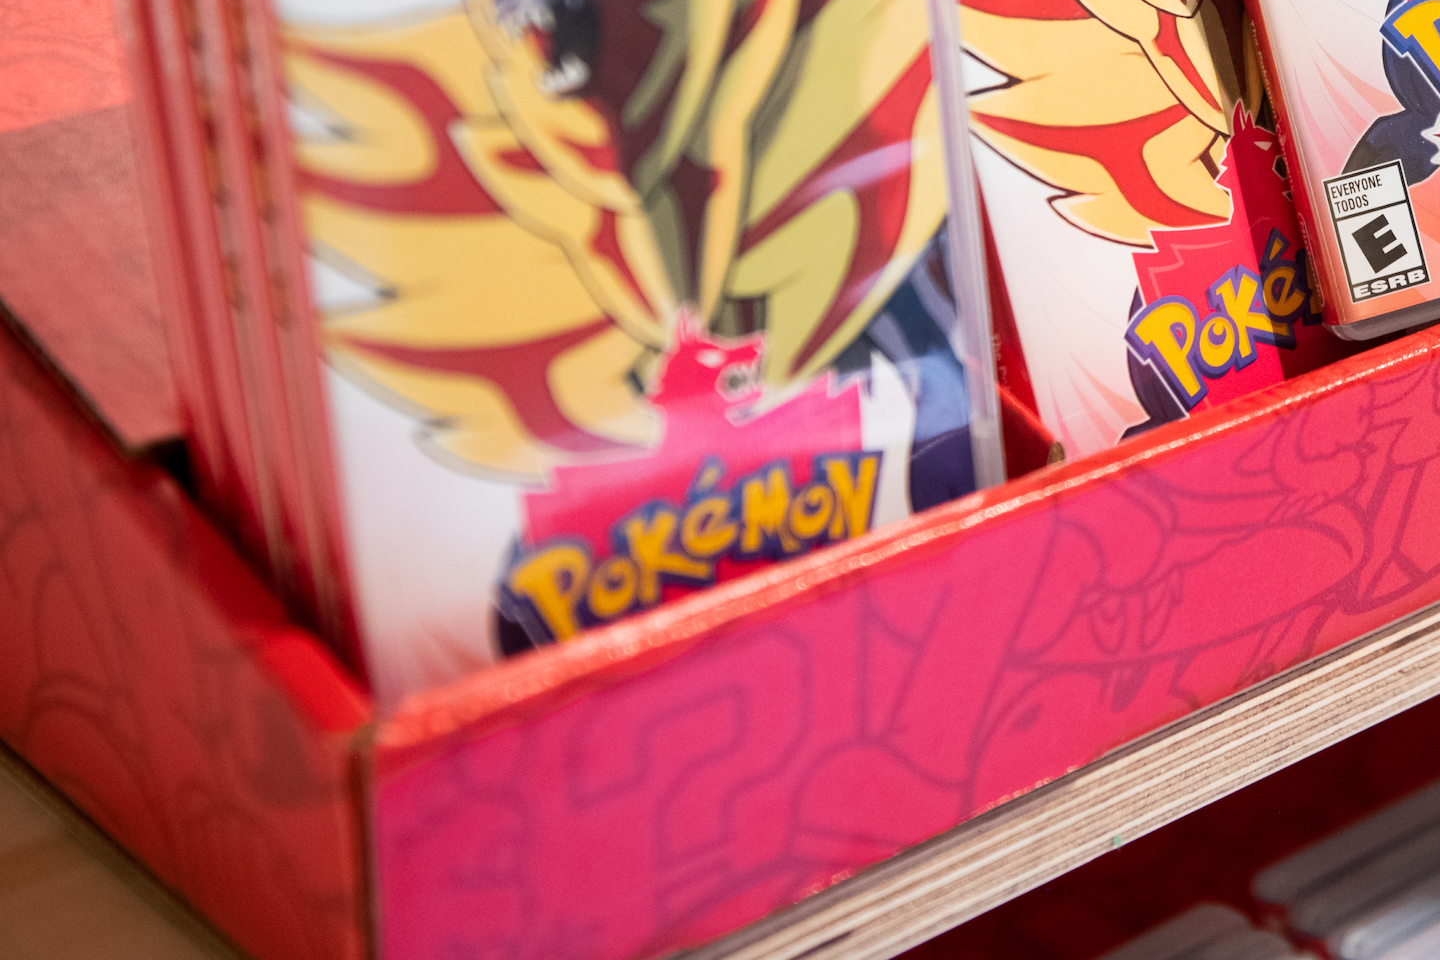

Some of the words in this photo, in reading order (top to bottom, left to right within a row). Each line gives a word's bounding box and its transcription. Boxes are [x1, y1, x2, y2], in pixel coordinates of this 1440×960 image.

[1330, 174, 1383, 199] EVERYONE
[1334, 194, 1370, 214] TODOS
[1351, 213, 1408, 274] E
[1352, 268, 1426, 300] ESRB
[493, 450, 884, 645] Pokémon
